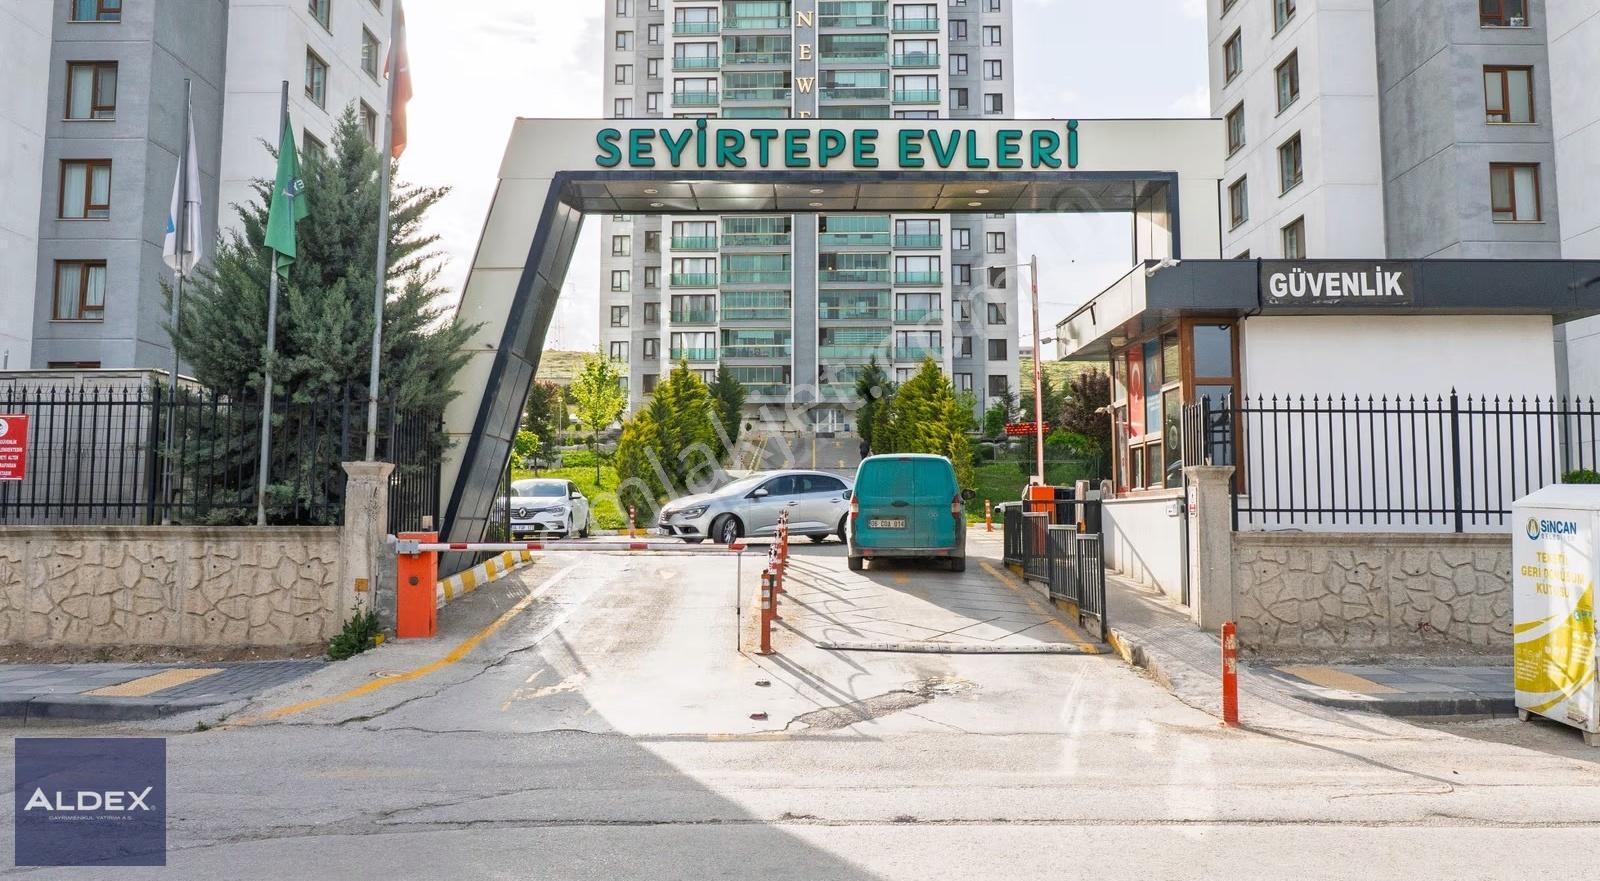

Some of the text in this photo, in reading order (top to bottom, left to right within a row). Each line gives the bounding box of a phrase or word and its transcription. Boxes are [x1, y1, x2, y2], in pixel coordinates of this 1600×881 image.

[595, 118, 1079, 168] SEYİRTEPE EVLERİ
[1269, 265, 1404, 298] GÜVENLİK
